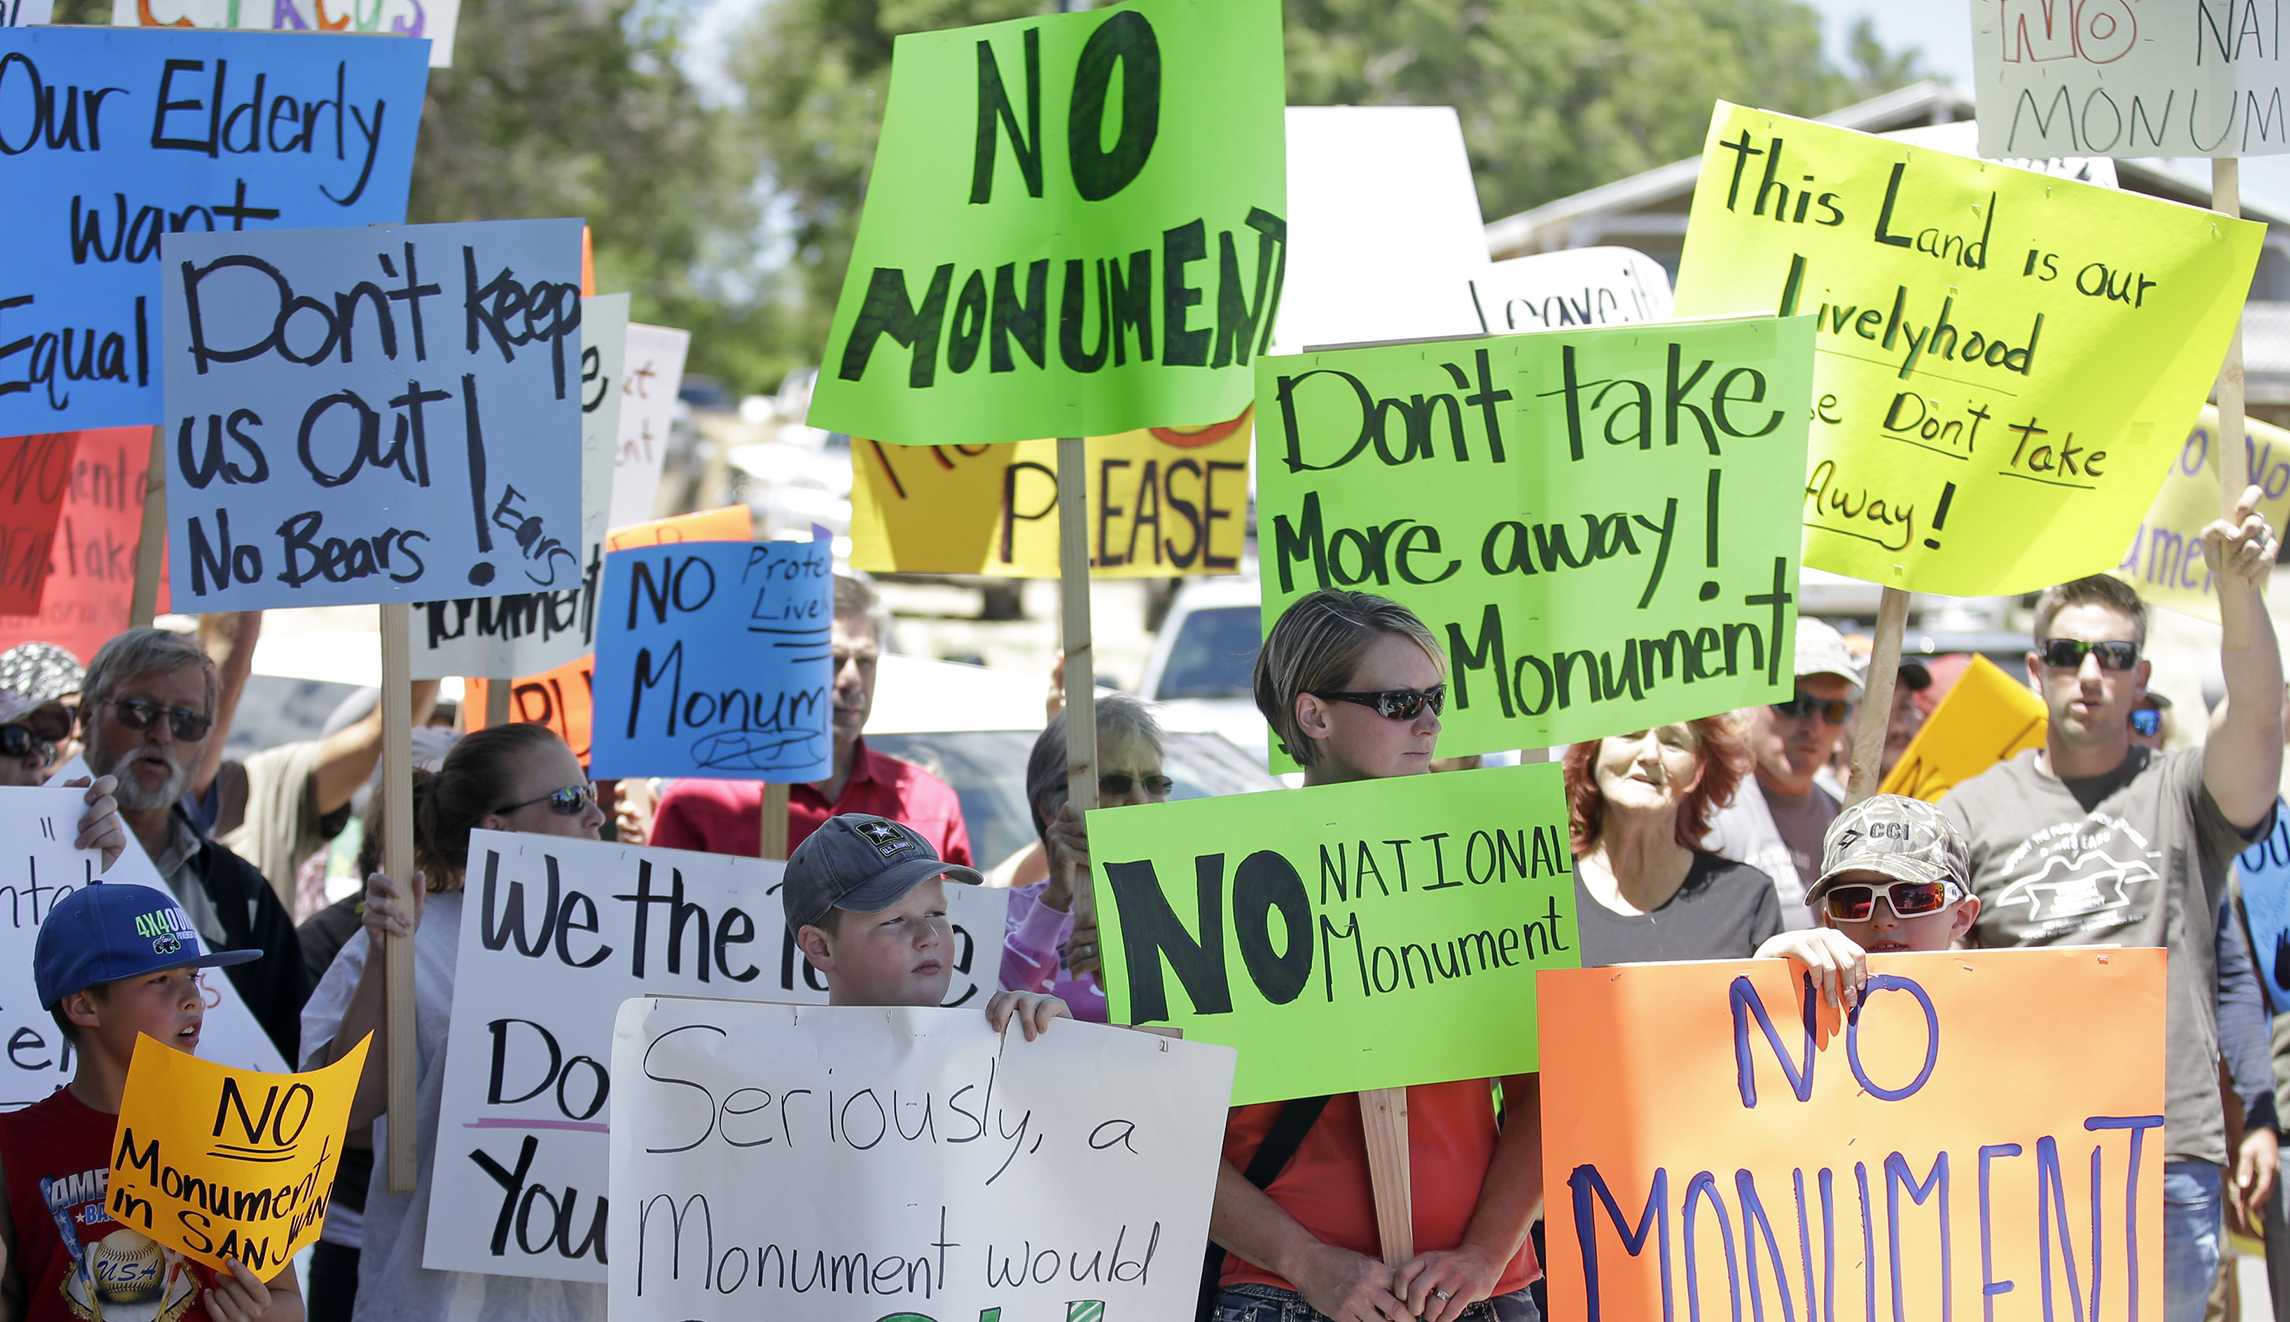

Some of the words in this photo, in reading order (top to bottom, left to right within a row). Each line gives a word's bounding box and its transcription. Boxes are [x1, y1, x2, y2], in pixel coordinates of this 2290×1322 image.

[2000, 0, 2137, 64] NO
[0, 52, 131, 155] Our
[151, 58, 386, 206] Elderly
[968, 10, 1163, 205] NO
[2008, 85, 2286, 153] MONUM
[1874, 162, 1997, 270] Land
[2022, 238, 2058, 282] is
[2075, 263, 2157, 309] our
[181, 241, 442, 375] Don't
[463, 245, 583, 400] keep
[838, 206, 1288, 389] MONUMENT
[177, 406, 271, 489] us
[1276, 347, 1514, 474] Don't
[1535, 342, 1786, 462] take
[188, 507, 263, 597] No
[276, 510, 432, 590] Bears
[1001, 457, 1246, 570] PEASE
[1273, 490, 1463, 594] More
[627, 556, 716, 630] NO
[1444, 556, 1794, 719] Monument
[1868, 822, 1911, 841] CCI
[480, 848, 614, 970] We
[611, 858, 761, 985] the
[1102, 849, 1315, 1026] NO
[1318, 824, 1573, 906] NATIONAL
[1318, 895, 1571, 1003] Monument
[1729, 970, 1940, 1109] NO
[211, 1076, 315, 1148] NO
[641, 1023, 1046, 1187] Seriously,
[1087, 1117, 1140, 1156] a
[112, 1183, 154, 1230] in
[115, 1127, 332, 1222] Monument
[97, 1258, 159, 1282] USA
[636, 1193, 963, 1300] Monument
[986, 1220, 1162, 1290] would
